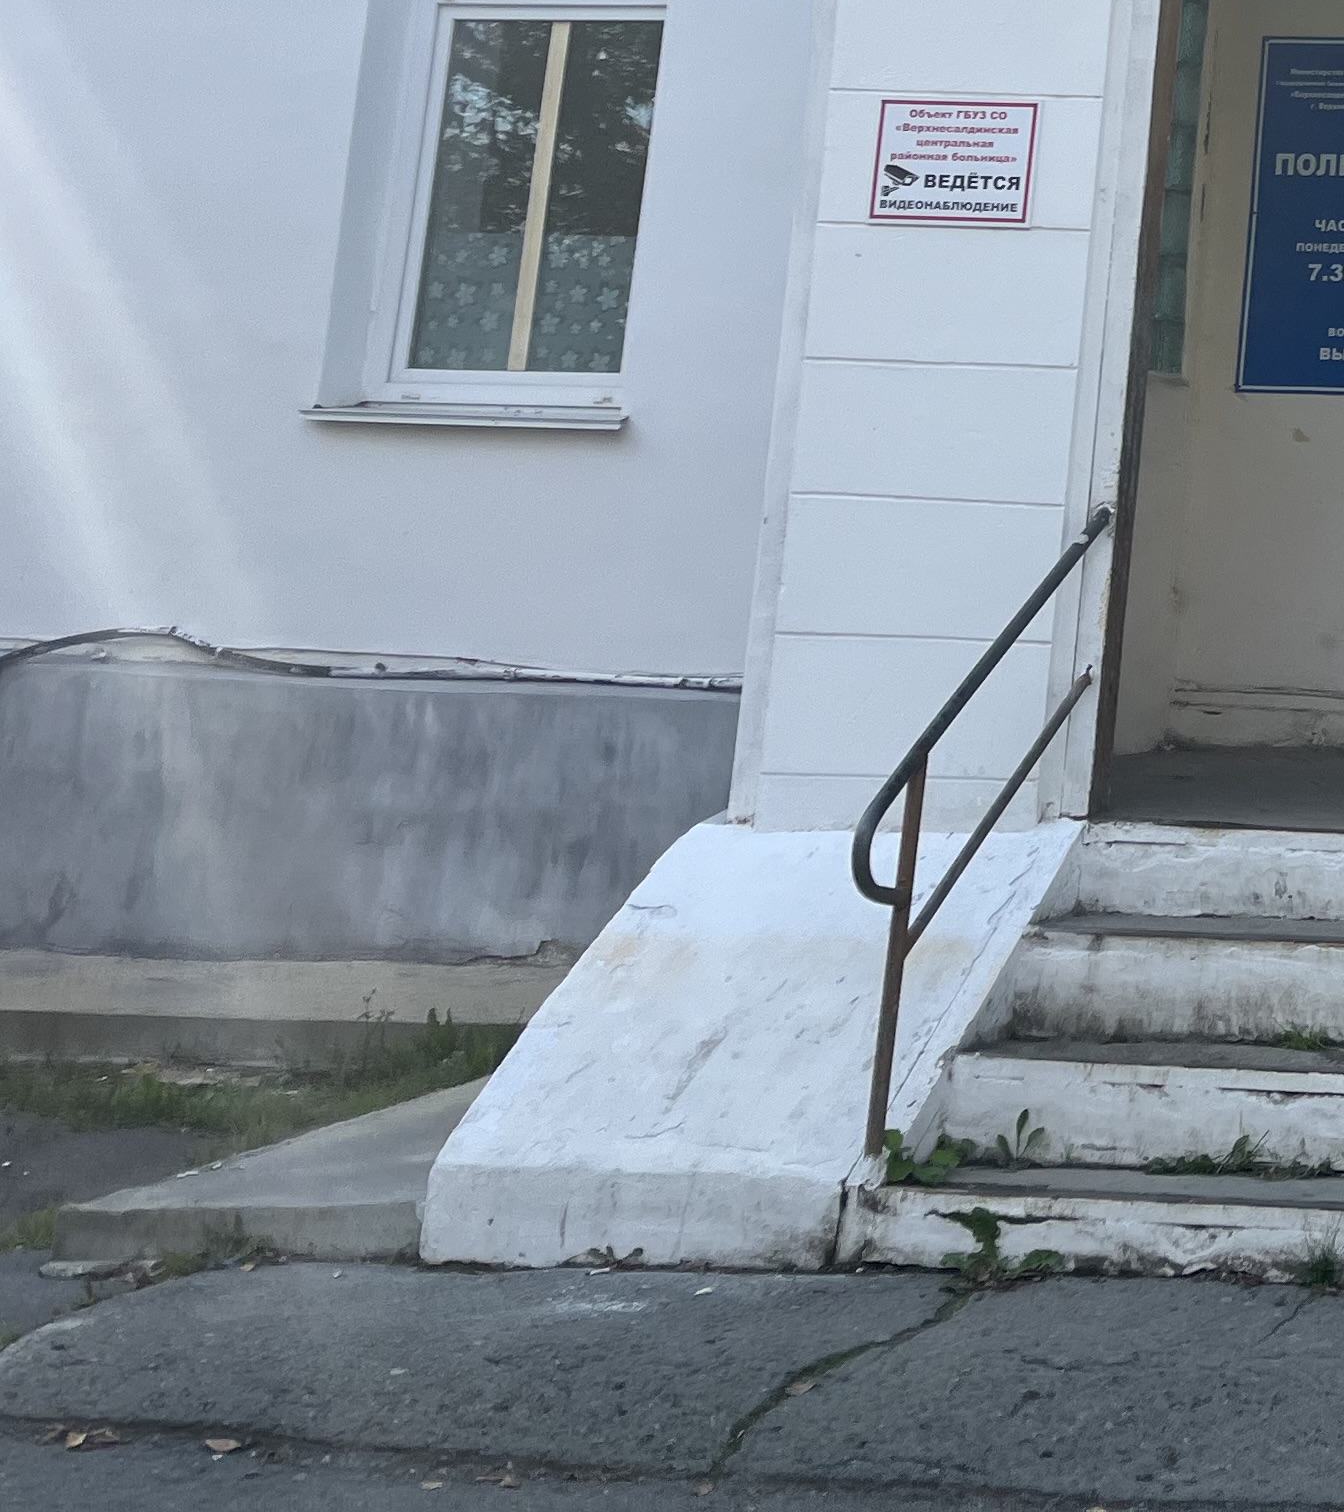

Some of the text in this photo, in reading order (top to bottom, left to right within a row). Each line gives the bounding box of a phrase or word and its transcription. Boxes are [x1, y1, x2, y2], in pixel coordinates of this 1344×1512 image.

[909, 109, 1008, 120] Объект ГБУЗ СО
[895, 123, 1019, 135] «Верхнесалдинская
[916, 139, 994, 149] центральная
[890, 152, 1017, 163] районная больница»
[924, 172, 1021, 191] ВЕДЁТСЯ
[879, 200, 1018, 213] ВИДЕОНАБЛЮДЕНИЕ
